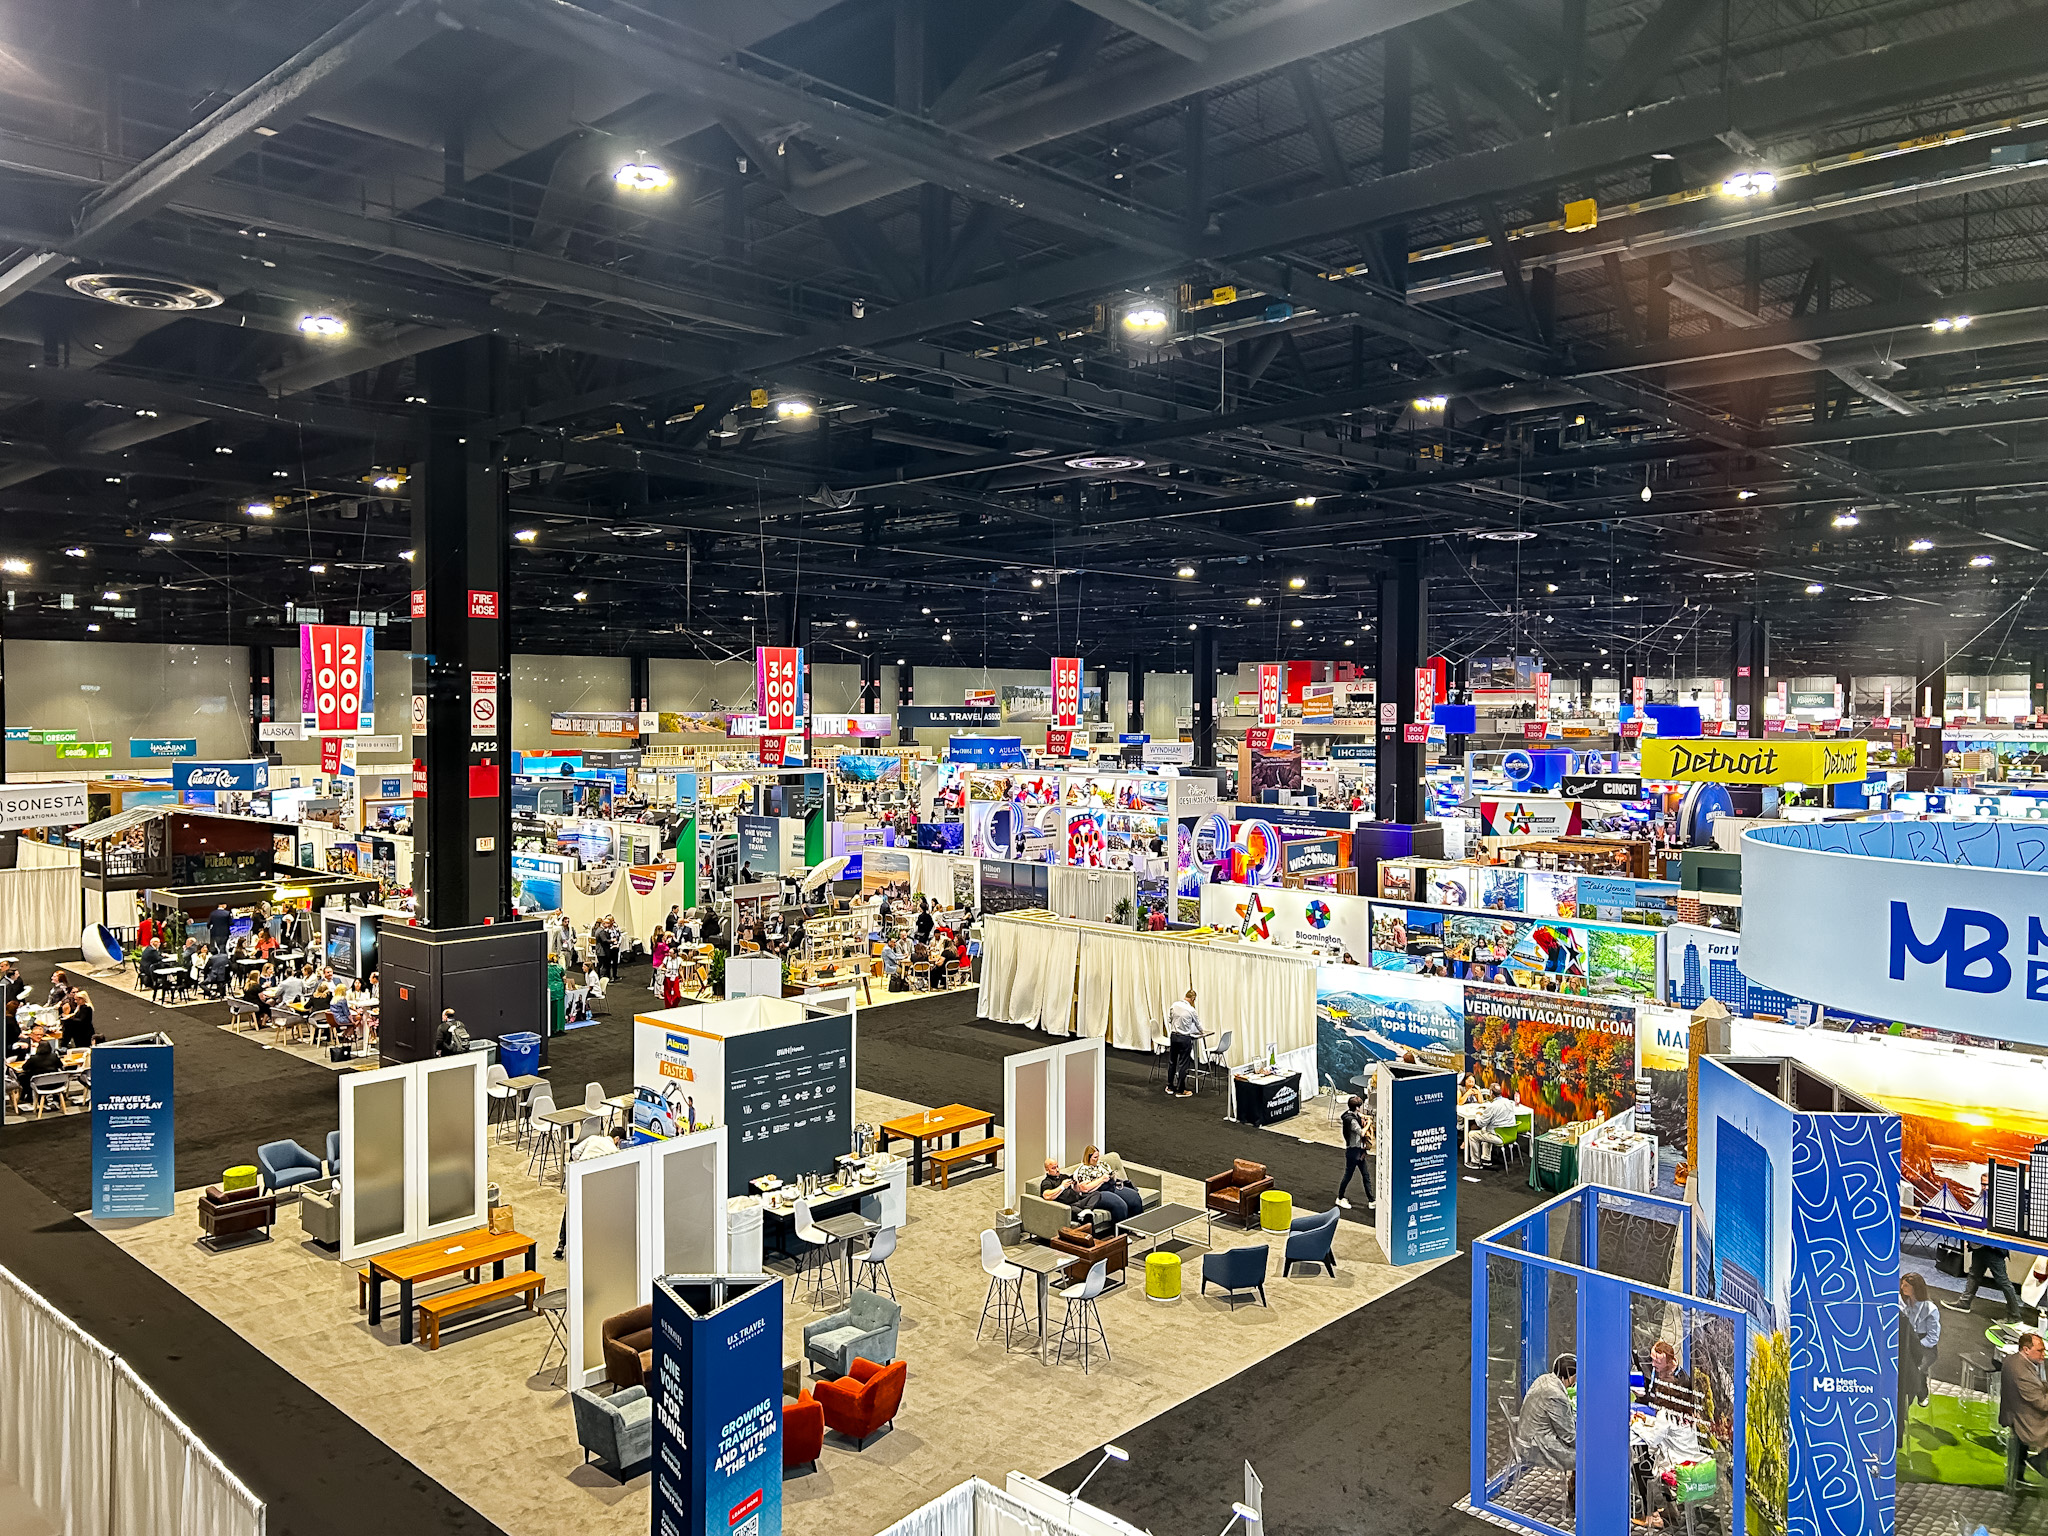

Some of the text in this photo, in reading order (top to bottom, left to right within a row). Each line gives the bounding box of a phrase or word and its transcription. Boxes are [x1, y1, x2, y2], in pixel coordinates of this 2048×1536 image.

[413, 593, 424, 604] FIRE
[472, 593, 493, 604] FIRE
[412, 604, 424, 615] HOSE
[471, 604, 495, 615] HOSE
[1346, 683, 1374, 692] CAFE
[930, 712, 982, 721] U.S. TRAVEL
[551, 718, 571, 731] AMERICA
[572, 719, 581, 731] THE
[600, 720, 622, 733] TRAVELED
[643, 719, 655, 727] USA
[46, 733, 76, 742] OREGON
[262, 727, 295, 737] ALASKA
[1050, 734, 1065, 742] 500
[1251, 730, 1268, 738] 700
[150, 742, 187, 754] HAWAIIAN
[325, 741, 336, 754] 100
[470, 741, 498, 752] AF12
[764, 739, 779, 749] 300
[1149, 746, 1182, 754] WYNDHAM
[764, 753, 780, 762] 400
[1337, 749, 1355, 757] IHG
[324, 758, 337, 771] 200
[1669, 744, 1779, 778] Detroit
[1823, 745, 1858, 781] Detroit
[187, 768, 217, 788] Puerto
[216, 769, 240, 788] Rico
[413, 771, 426, 781] FIRE
[412, 782, 427, 792] HOSE
[1565, 779, 1637, 796] Cleveland CINCY!
[6, 795, 84, 813] SONESTA
[6, 813, 58, 822] INTERNATIONAL
[744, 828, 772, 837] ONE VOICE
[480, 839, 492, 848] EXIT
[748, 843, 768, 852] TRAVEL
[1303, 845, 1322, 853] TRAVEL
[1288, 852, 1337, 871] WISCONSIN
[982, 864, 1001, 873] Hilton
[1587, 881, 1632, 894] Lake Geneva
[1647, 901, 1666, 909] PLACE
[1295, 930, 1342, 945] Bloomington
[1708, 943, 1730, 955] Fort
[1888, 900, 2012, 994] MB
[1475, 993, 1491, 1001] START
[1492, 996, 1519, 1005] PLANNING
[1520, 999, 1534, 1007] YOUR
[1536, 1002, 1561, 1010] VERMONT
[1563, 1005, 1589, 1015] VACATION
[1590, 1009, 1608, 1017] TODAY
[1369, 1004, 1456, 1028] Take a trip that
[1465, 999, 1633, 1037] VERMONTVACATION.COM
[1380, 1018, 1459, 1041] tops them all.
[667, 1037, 689, 1052] Alamo
[109, 1095, 151, 1103] TRAVEL'S
[1424, 1091, 1444, 1101] TRAVEL
[140, 1102, 163, 1110] PLAY
[1270, 1108, 1282, 1118] LIVE
[1412, 1126, 1446, 1139] TRAVEL'S
[1410, 1134, 1448, 1147] ECONOMIC
[1416, 1142, 1442, 1154] IMPACT
[727, 1317, 766, 1346] U.S. TRAVEL
[663, 1353, 681, 1383] ONE
[660, 1367, 684, 1407] VOICE
[1813, 1376, 1835, 1392] MB
[1836, 1377, 1858, 1386] Meet
[1669, 1382, 1690, 1394] Boston
[1836, 1385, 1874, 1394] BOSTON
[663, 1390, 680, 1423] FOR
[1671, 1395, 1691, 1408] Boston
[721, 1397, 771, 1438] GROWING
[656, 1402, 687, 1450] TRAVEL
[717, 1410, 774, 1454] TRAVEL TO
[714, 1420, 777, 1472] AND WITHIN
[725, 1446, 767, 1478] THE U.S.
[731, 1495, 759, 1521] LEARN MORE
